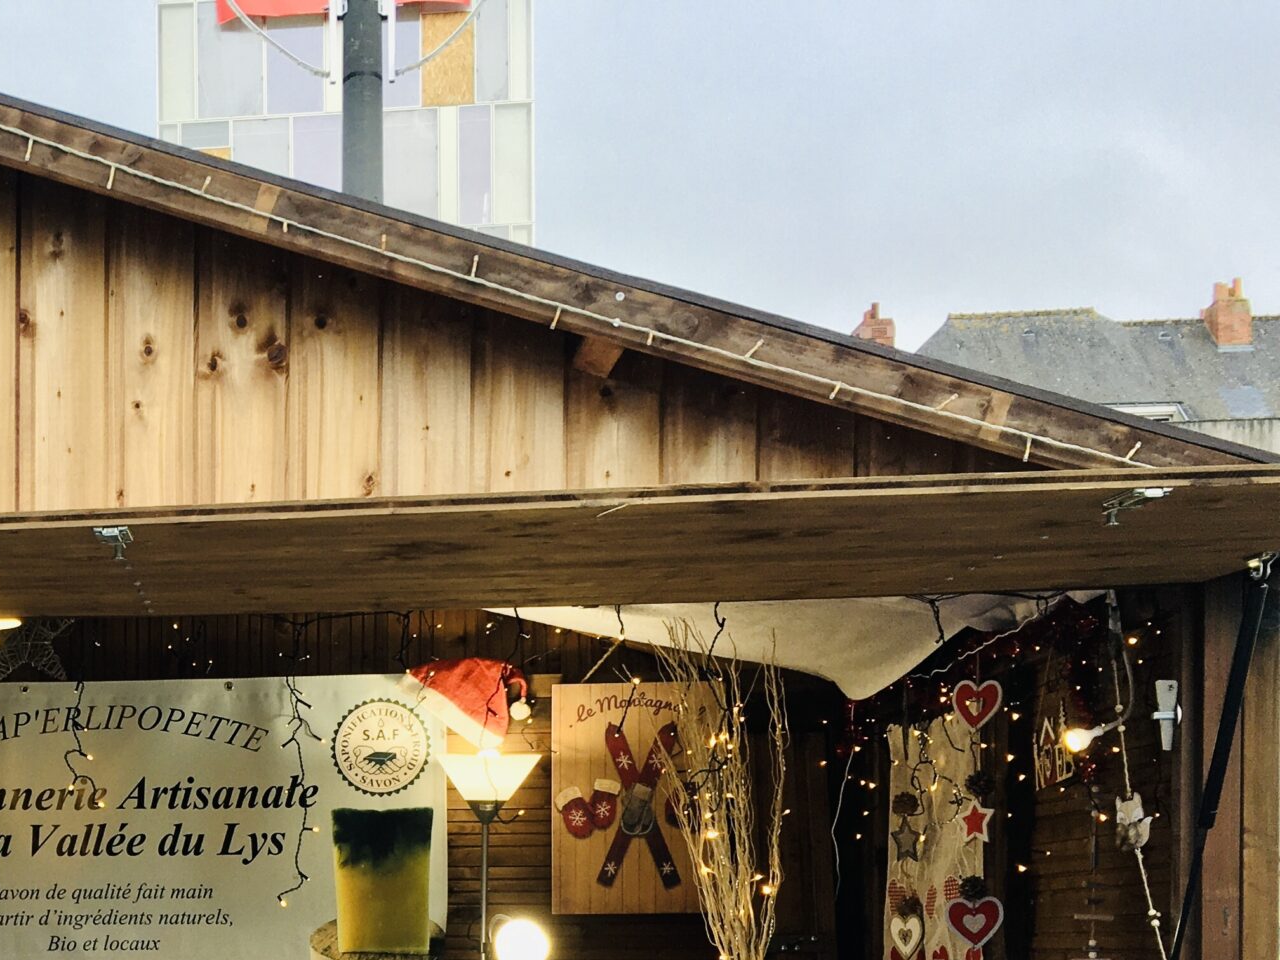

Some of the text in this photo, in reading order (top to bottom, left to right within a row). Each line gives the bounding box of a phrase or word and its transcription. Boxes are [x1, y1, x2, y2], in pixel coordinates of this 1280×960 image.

[576, 704, 597, 722] le
[359, 774, 402, 788] SAVON
[116, 775, 320, 811] Artisanale
[29, 823, 147, 858] Vallée
[158, 822, 205, 857] du
[217, 822, 286, 866] Lys
[45, 883, 67, 900] de
[71, 882, 132, 905] qualité
[131, 882, 166, 904] fait
[170, 884, 213, 900] main
[38, 909, 153, 930] d'ingrédients
[158, 909, 234, 928] naturels,
[47, 935, 161, 952] Bio et locaux
